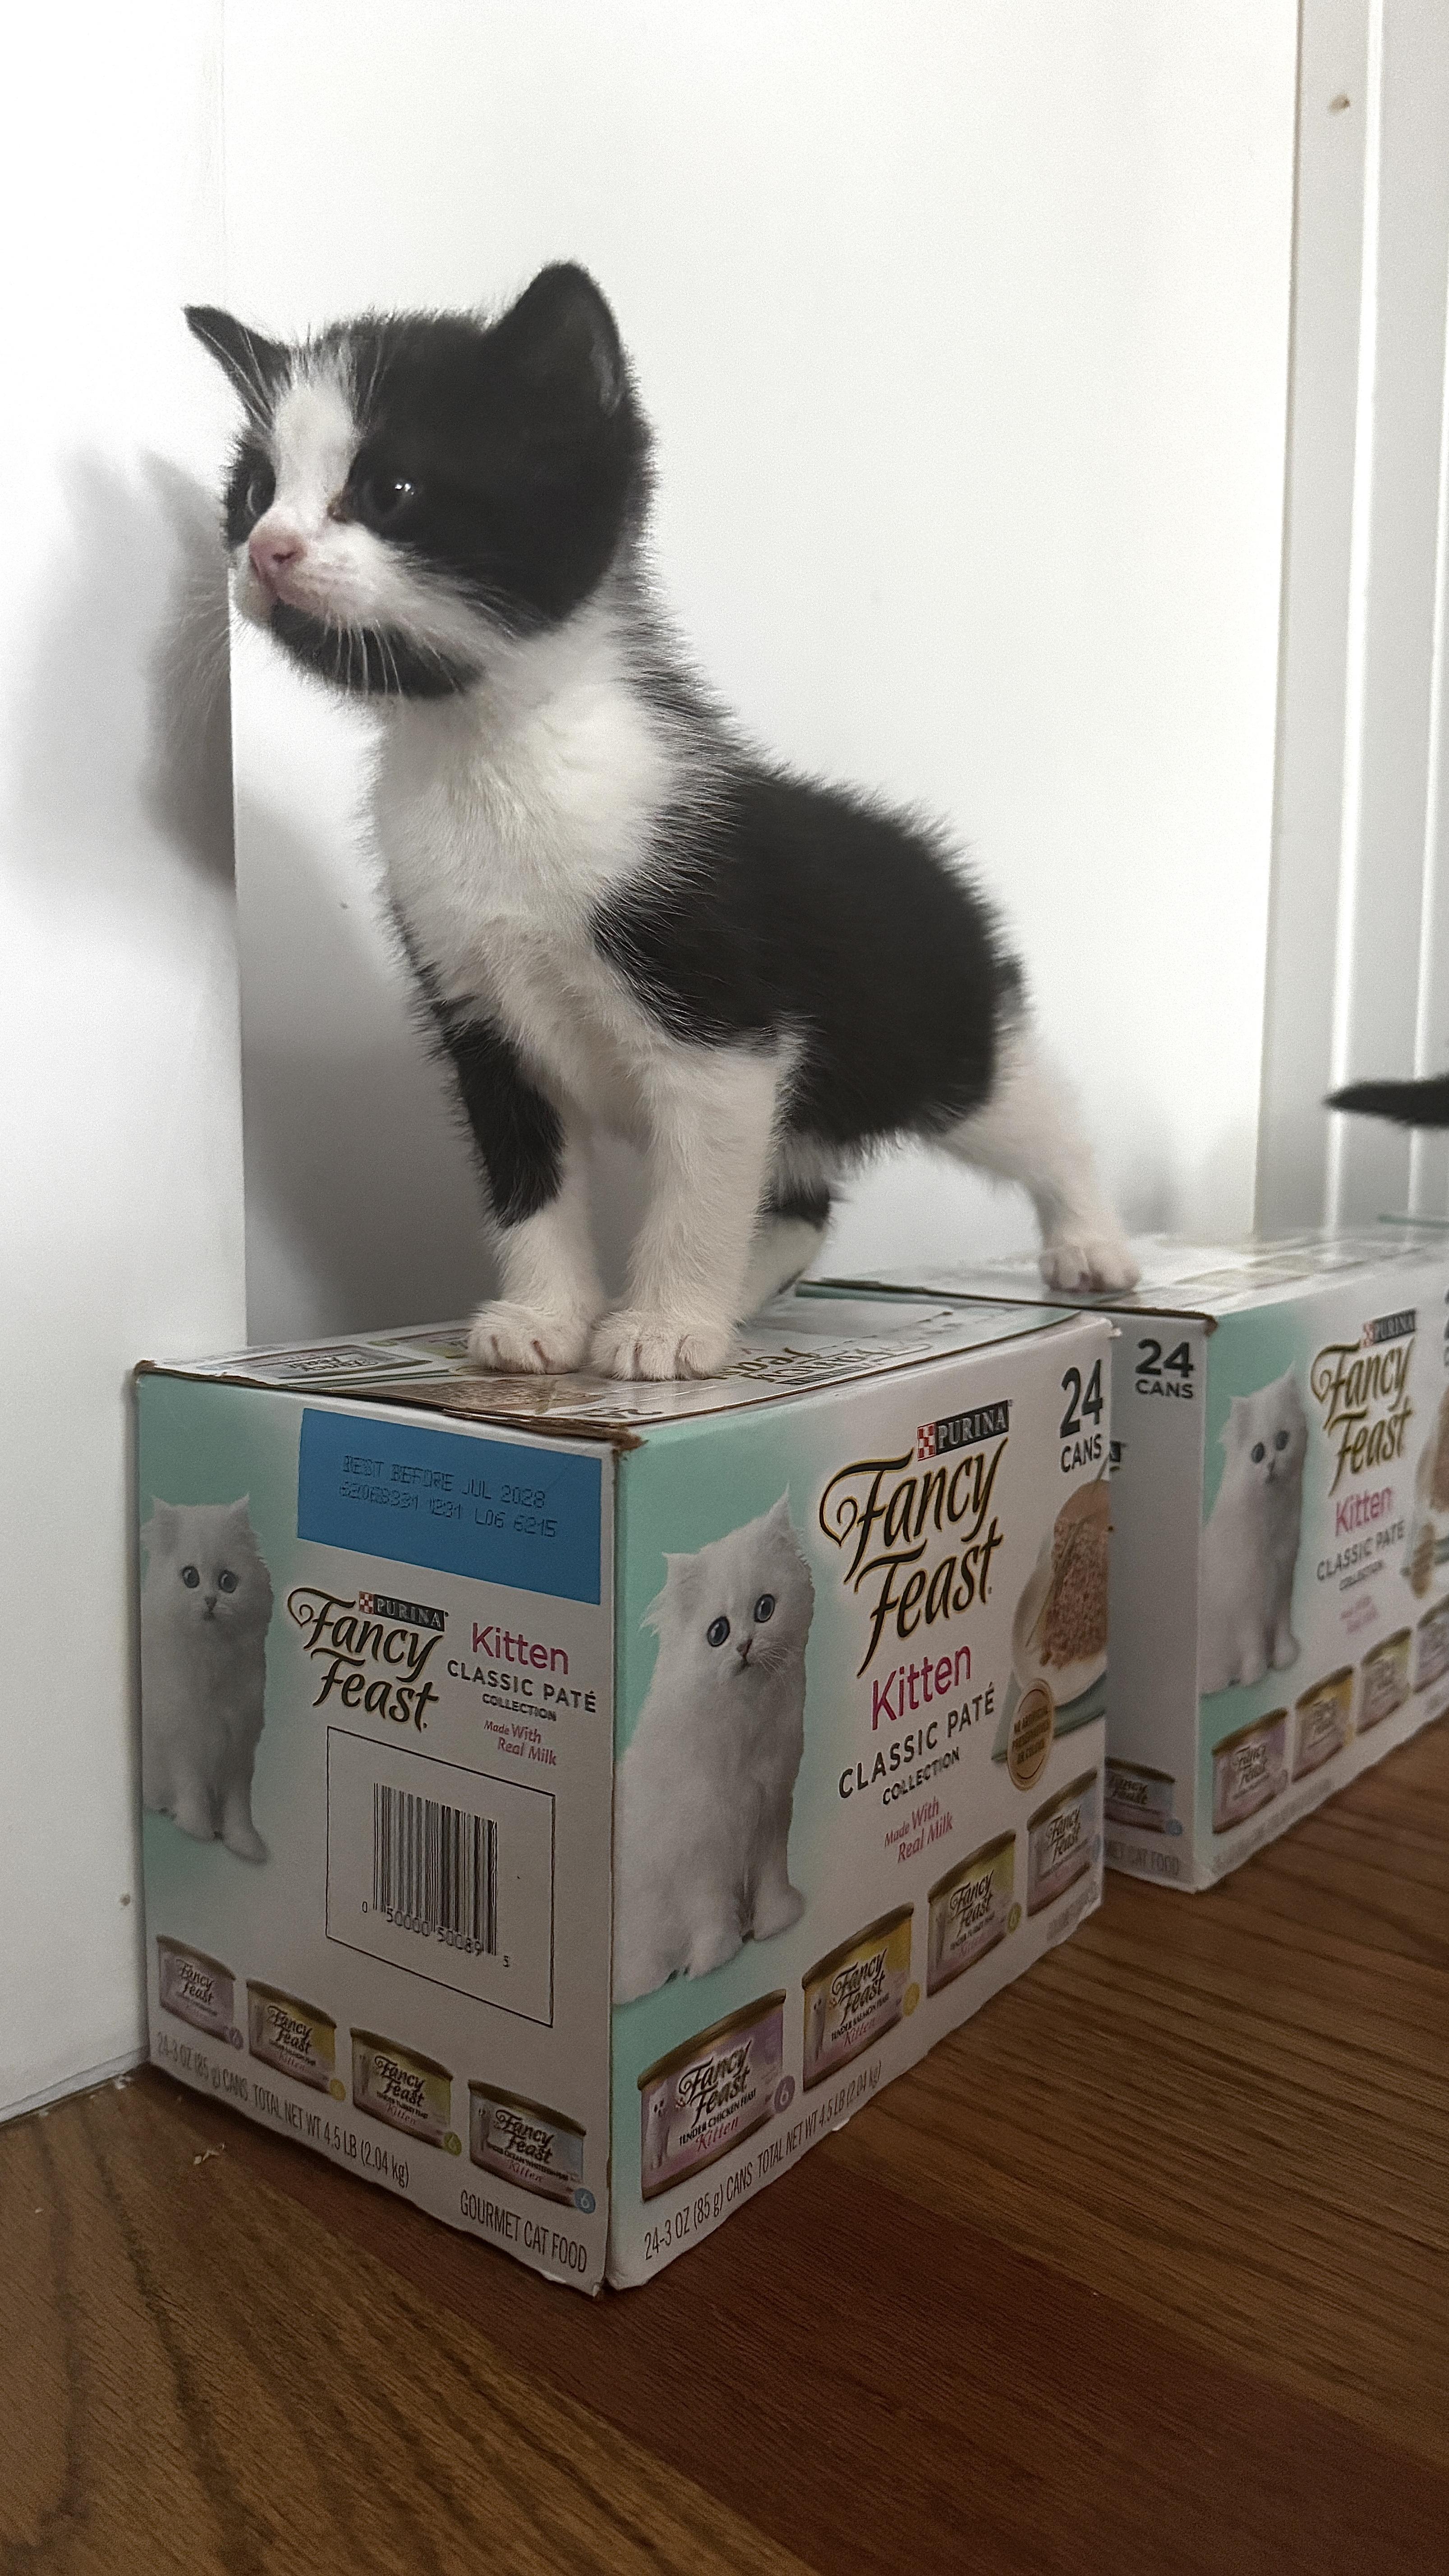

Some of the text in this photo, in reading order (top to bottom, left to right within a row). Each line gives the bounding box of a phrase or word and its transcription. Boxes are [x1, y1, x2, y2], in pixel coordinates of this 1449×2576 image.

[740, 1343, 932, 1383] Fancy
[1136, 1338, 1193, 1378] 24
[1311, 1336, 1415, 1429] Fancy
[1060, 1359, 1103, 1438] 24
[1136, 1379, 1193, 1398] CANS
[938, 1405, 1006, 1449] PURINA
[1328, 1396, 1412, 1497] Feast
[1061, 1434, 1101, 1473] CANS
[391, 1464, 454, 1491] BEFORE
[462, 1479, 492, 1500] JUL
[501, 1485, 545, 1508] 2028
[819, 1437, 1008, 1584] Fancy
[475, 1509, 506, 1528] L06
[514, 1514, 557, 1537] 6215
[1335, 1487, 1392, 1536] Kitten
[1316, 1536, 1374, 1581] CLASSIC
[377, 1598, 441, 1629] PURINA
[854, 1517, 1003, 1679] Feast
[288, 1587, 443, 1683] Fancy
[473, 1622, 568, 1674] Kitten
[311, 1647, 439, 1732] Feast
[447, 1660, 596, 1713] CLASSIC PATÉ
[482, 1693, 557, 1721] COLLECTION
[872, 1646, 971, 1730] Kitten
[483, 1720, 541, 1744] Made With
[498, 1737, 557, 1766] Real Milk
[838, 1721, 938, 1798] CLASSIC
[948, 1682, 994, 1738] PATÉ
[883, 1747, 959, 1805] COLLECTION
[885, 1796, 939, 1847] Made With
[897, 1812, 953, 1863] Real Milk
[950, 1869, 994, 1918] Fancy
[956, 1893, 993, 1939] Feast
[362, 1901, 368, 1913] 0
[386, 1908, 431, 1937] 50000
[503, 1955, 510, 1967] 5
[176, 1959, 214, 1992] Fancy
[832, 1948, 887, 2004] Fancy
[840, 1970, 885, 2025] Feast
[268, 2006, 313, 2040] Fancy
[276, 2023, 312, 2052] Feast
[375, 2055, 425, 2092] Fancy
[382, 2075, 424, 2107] Feast
[679, 2040, 752, 2105] Fancy
[690, 2065, 750, 2129] Feast
[780, 2083, 789, 2106] 6
[253, 2084, 284, 2120] TOTAL
[285, 2100, 303, 2129] NET
[306, 2111, 322, 2139] WT
[324, 2122, 340, 2150] 4.5
[344, 2131, 357, 2158] LB
[361, 2139, 388, 2175] (2.04
[392, 2155, 409, 2188] kg)
[496, 2109, 555, 2148] Fancy
[503, 2130, 552, 2163] Feast
[679, 2121, 706, 2146] TENDER
[708, 2099, 740, 2128] CHICKEN
[696, 2116, 738, 2151] Kitten
[644, 2219, 672, 2260] 24-3
[675, 2206, 690, 2238] OZ
[694, 2192, 709, 2230] (85
[713, 2184, 723, 2217] g)
[727, 2162, 752, 2201] CANS
[758, 2138, 783, 2178] TOTAL
[786, 2121, 803, 2155] NET
[805, 2110, 818, 2139] WT
[819, 2098, 833, 2127] 4.5
[834, 2089, 845, 2115] LB
[460, 2189, 587, 2272] GOURMET CAT FOOD
